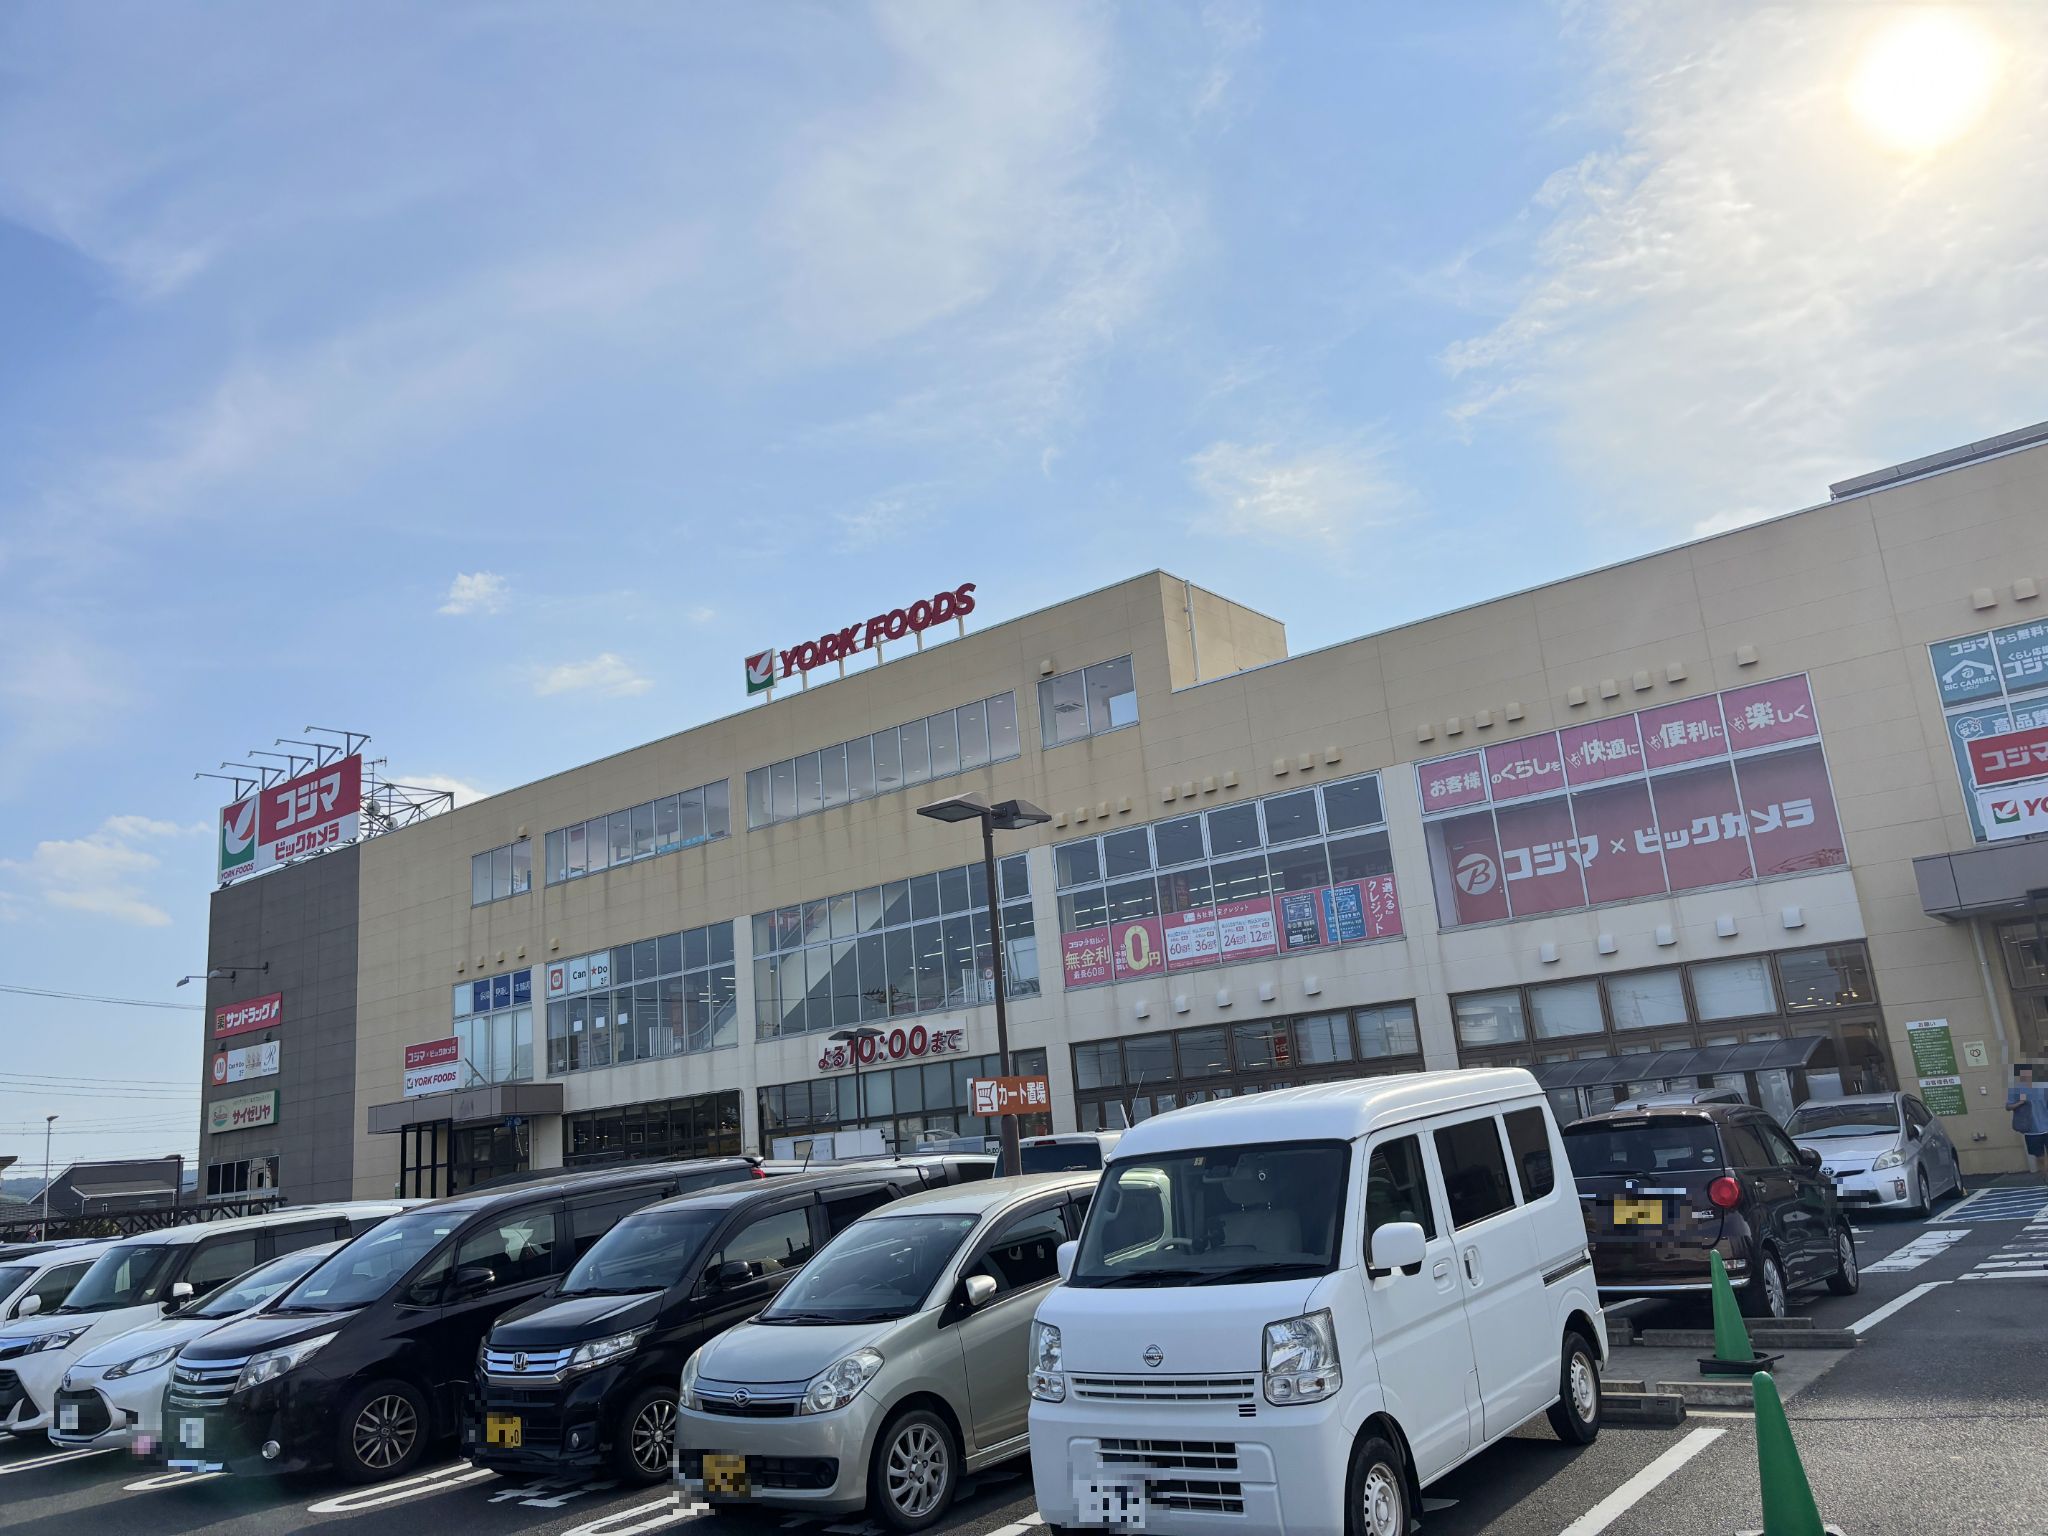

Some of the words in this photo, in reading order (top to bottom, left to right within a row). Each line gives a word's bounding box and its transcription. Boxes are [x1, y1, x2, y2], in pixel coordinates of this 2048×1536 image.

[780, 623, 862, 678] YORK
[864, 582, 976, 649] FOODS
[1960, 675, 1997, 687] CAMERA
[276, 772, 340, 830] コジマ
[275, 822, 339, 860] ビックカメラ
[1503, 835, 1599, 881] コジマ
[1634, 798, 1815, 854] ビックカメラ
[221, 869, 235, 881] YORK
[235, 863, 254, 875] FOODS
[1368, 880, 1383, 935] クレジット
[1066, 945, 1110, 970] 無金利
[227, 1003, 270, 1029] サンドラッグ
[408, 1051, 425, 1064] コジマ
[415, 1074, 433, 1087] YORK
[433, 1071, 456, 1084] FOODS
[998, 1081, 1047, 1105] カート置場
[233, 1105, 270, 1125] サイゼリヤ
